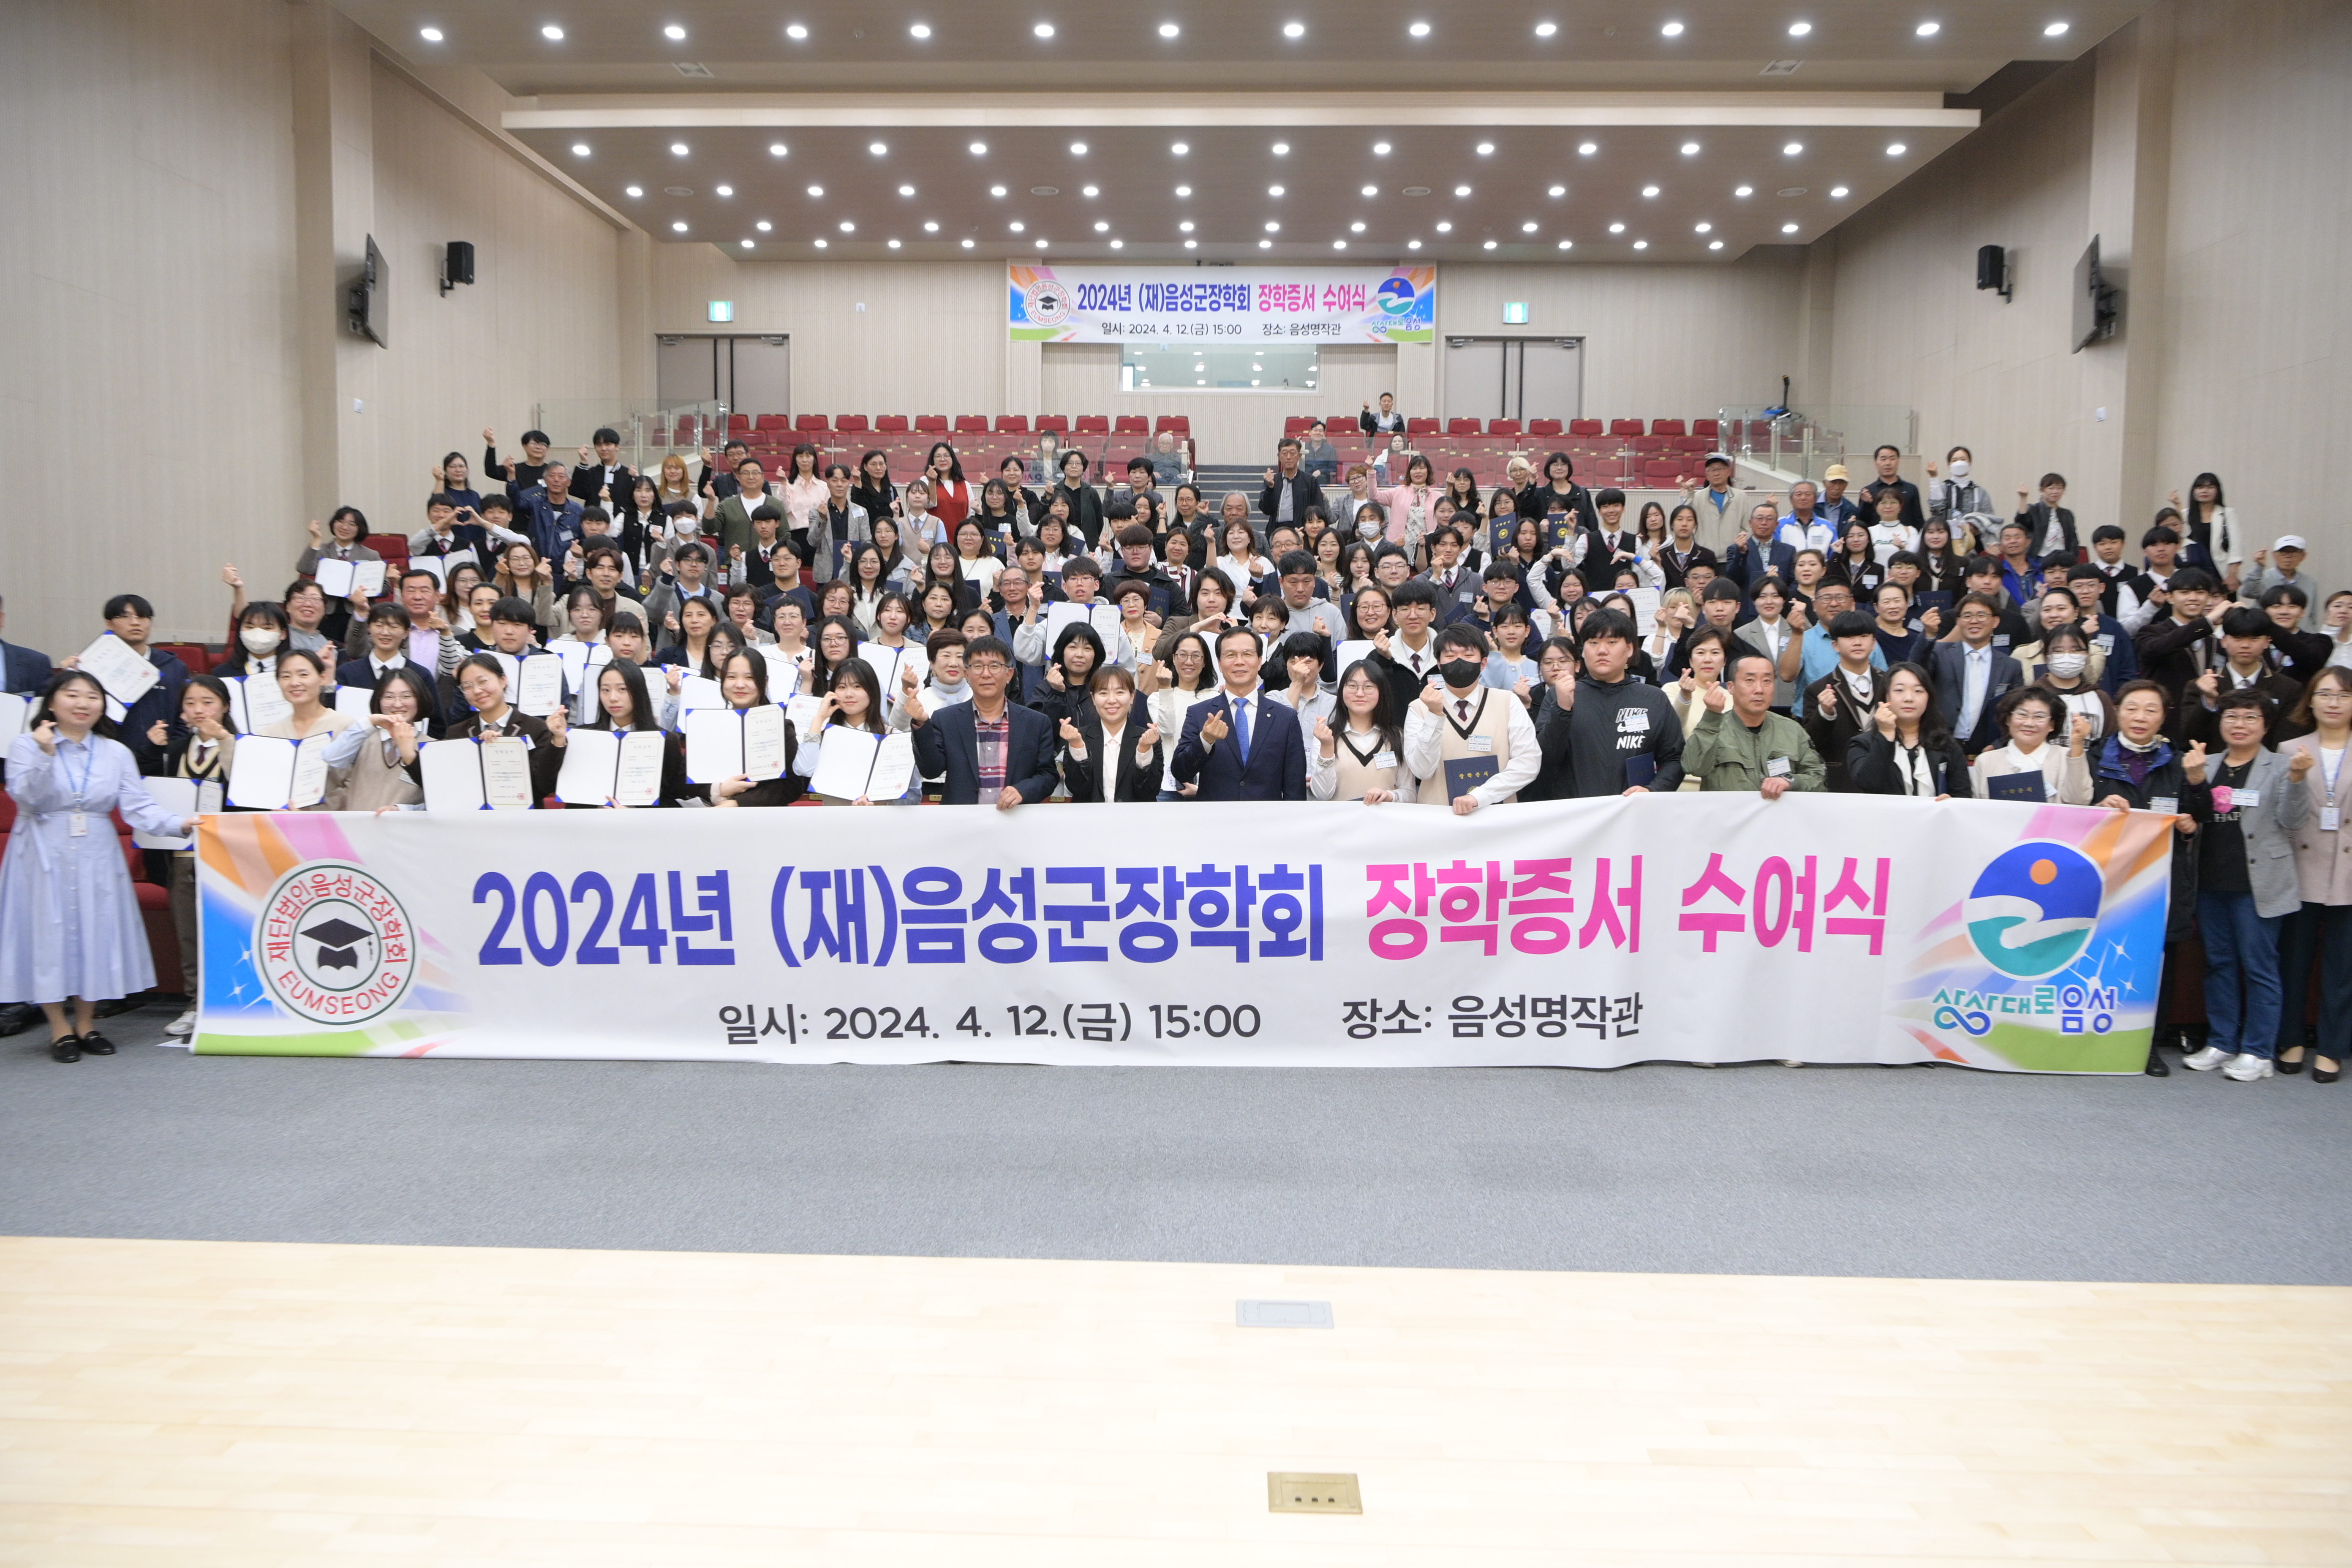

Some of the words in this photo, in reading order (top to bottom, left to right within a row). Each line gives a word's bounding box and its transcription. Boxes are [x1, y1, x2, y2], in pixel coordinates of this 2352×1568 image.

[1078, 283, 1131, 311] 2024년
[1139, 283, 1250, 312] (재)음성군장학회
[1259, 284, 1315, 312] 장학증서
[1323, 284, 1365, 312] 수여식
[1031, 310, 1065, 324] EUMSEONG
[1102, 322, 1124, 335] 일시:
[1129, 324, 1158, 335] 2024.
[1163, 324, 1172, 335] 4.
[1176, 324, 1209, 335] 12.(금)
[1213, 324, 1242, 335] 15:00
[1263, 323, 1285, 336] 장소:
[1290, 323, 1341, 336] 음성명작관
[1406, 318, 1421, 331] 음성
[1616, 735, 1646, 749] NIKE
[473, 870, 736, 967] 2024년
[771, 864, 1323, 967] (재)음성군장학회
[1366, 855, 1643, 961] 장학증서
[1679, 852, 1891, 956] 수여식
[278, 970, 400, 1015] EUMSEONG
[719, 1004, 808, 1045] 일시:
[824, 1006, 939, 1040] 2024.
[956, 1006, 991, 1039] 4.
[1006, 1002, 1132, 1043] 12.(금)
[1149, 1004, 1261, 1039] 15:00
[1342, 998, 1432, 1040] 장소:
[1448, 992, 1644, 1040] 음성명작관
[2062, 987, 2115, 1033] 음성
